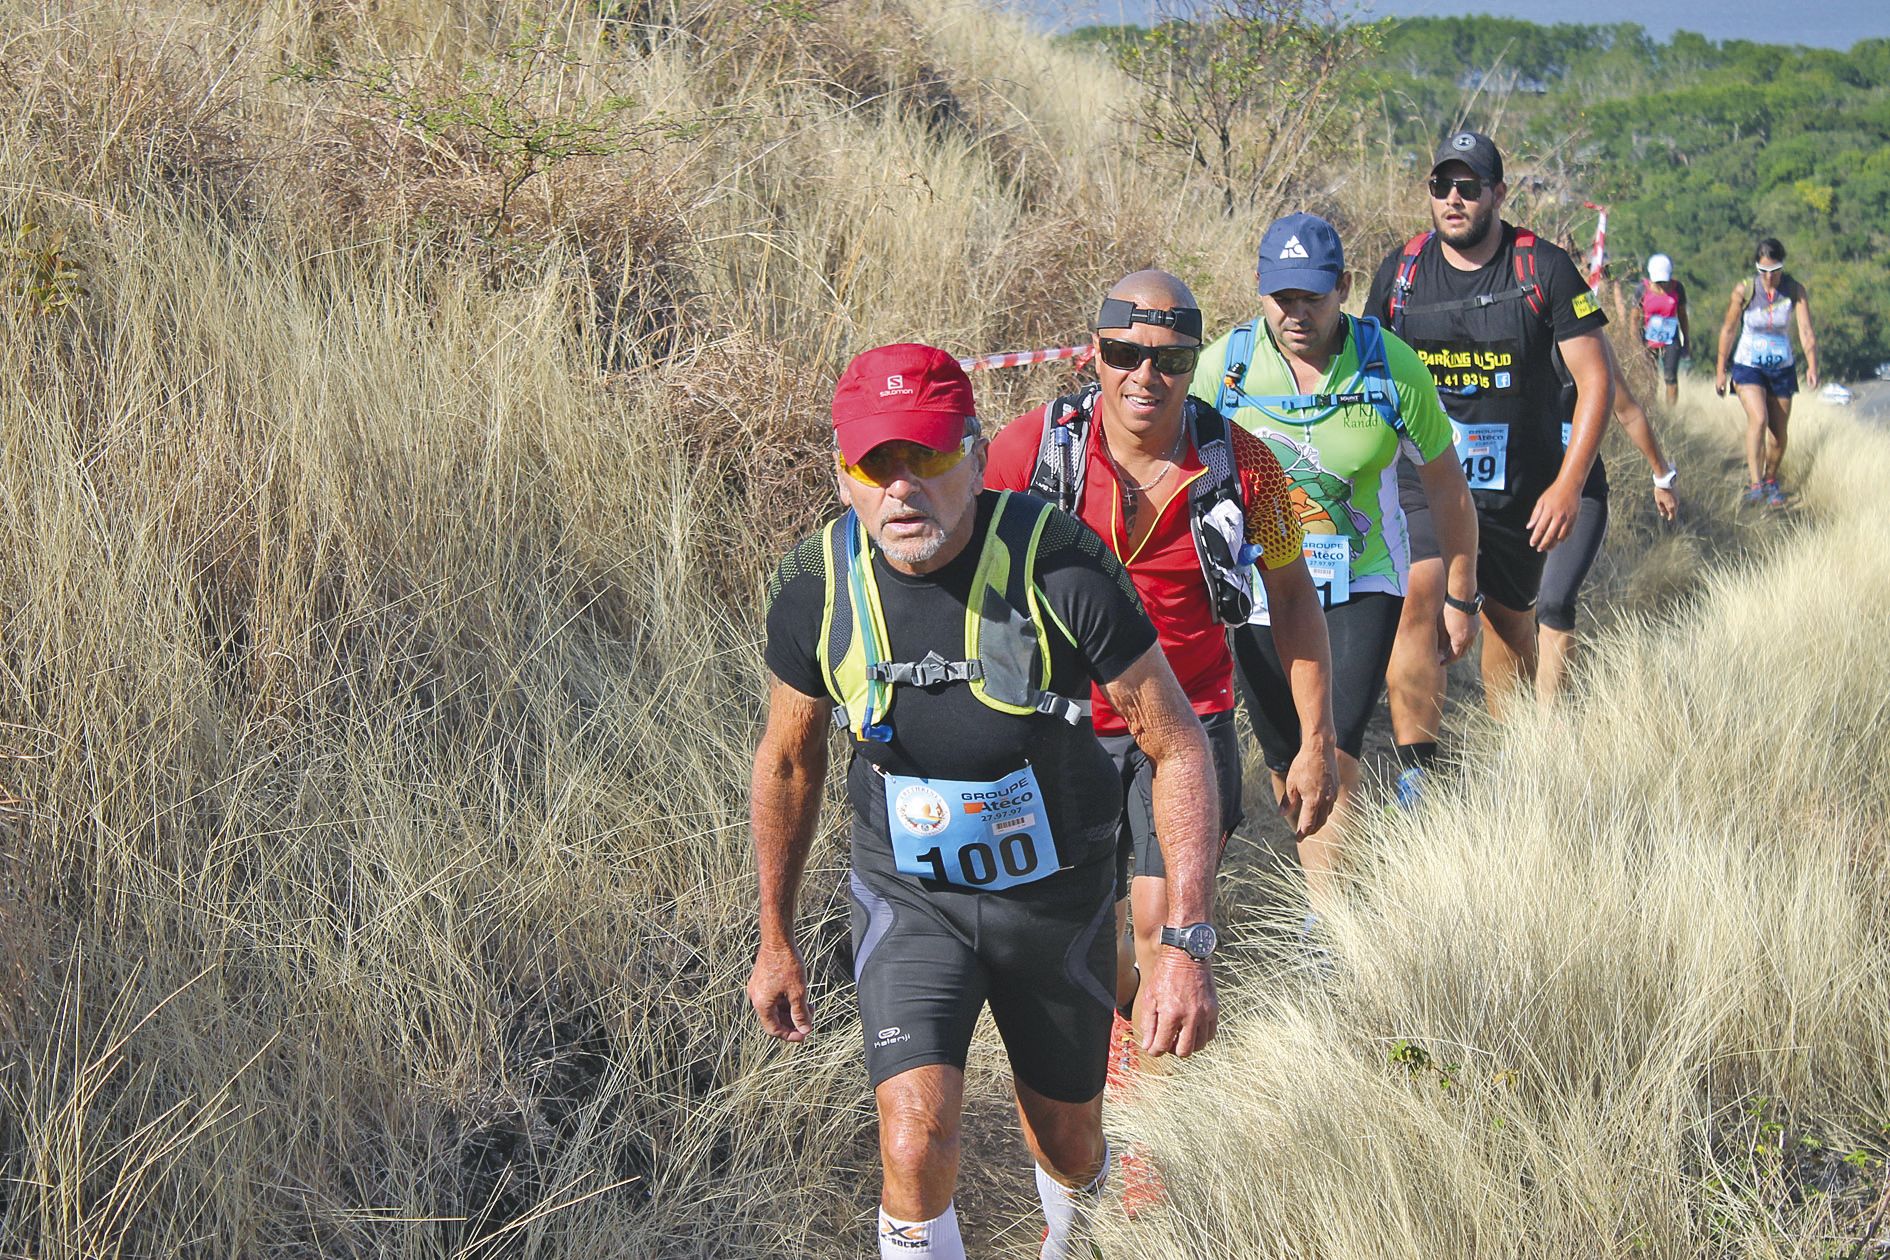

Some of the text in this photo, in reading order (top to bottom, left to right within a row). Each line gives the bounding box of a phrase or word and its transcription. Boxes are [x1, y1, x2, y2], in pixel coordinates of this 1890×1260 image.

[1444, 374, 1458, 386] 41
[1462, 373, 1479, 386] 93
[961, 777, 1029, 800] GROUPE
[981, 807, 1022, 822] 27.97.97
[916, 832, 1038, 886] 100
